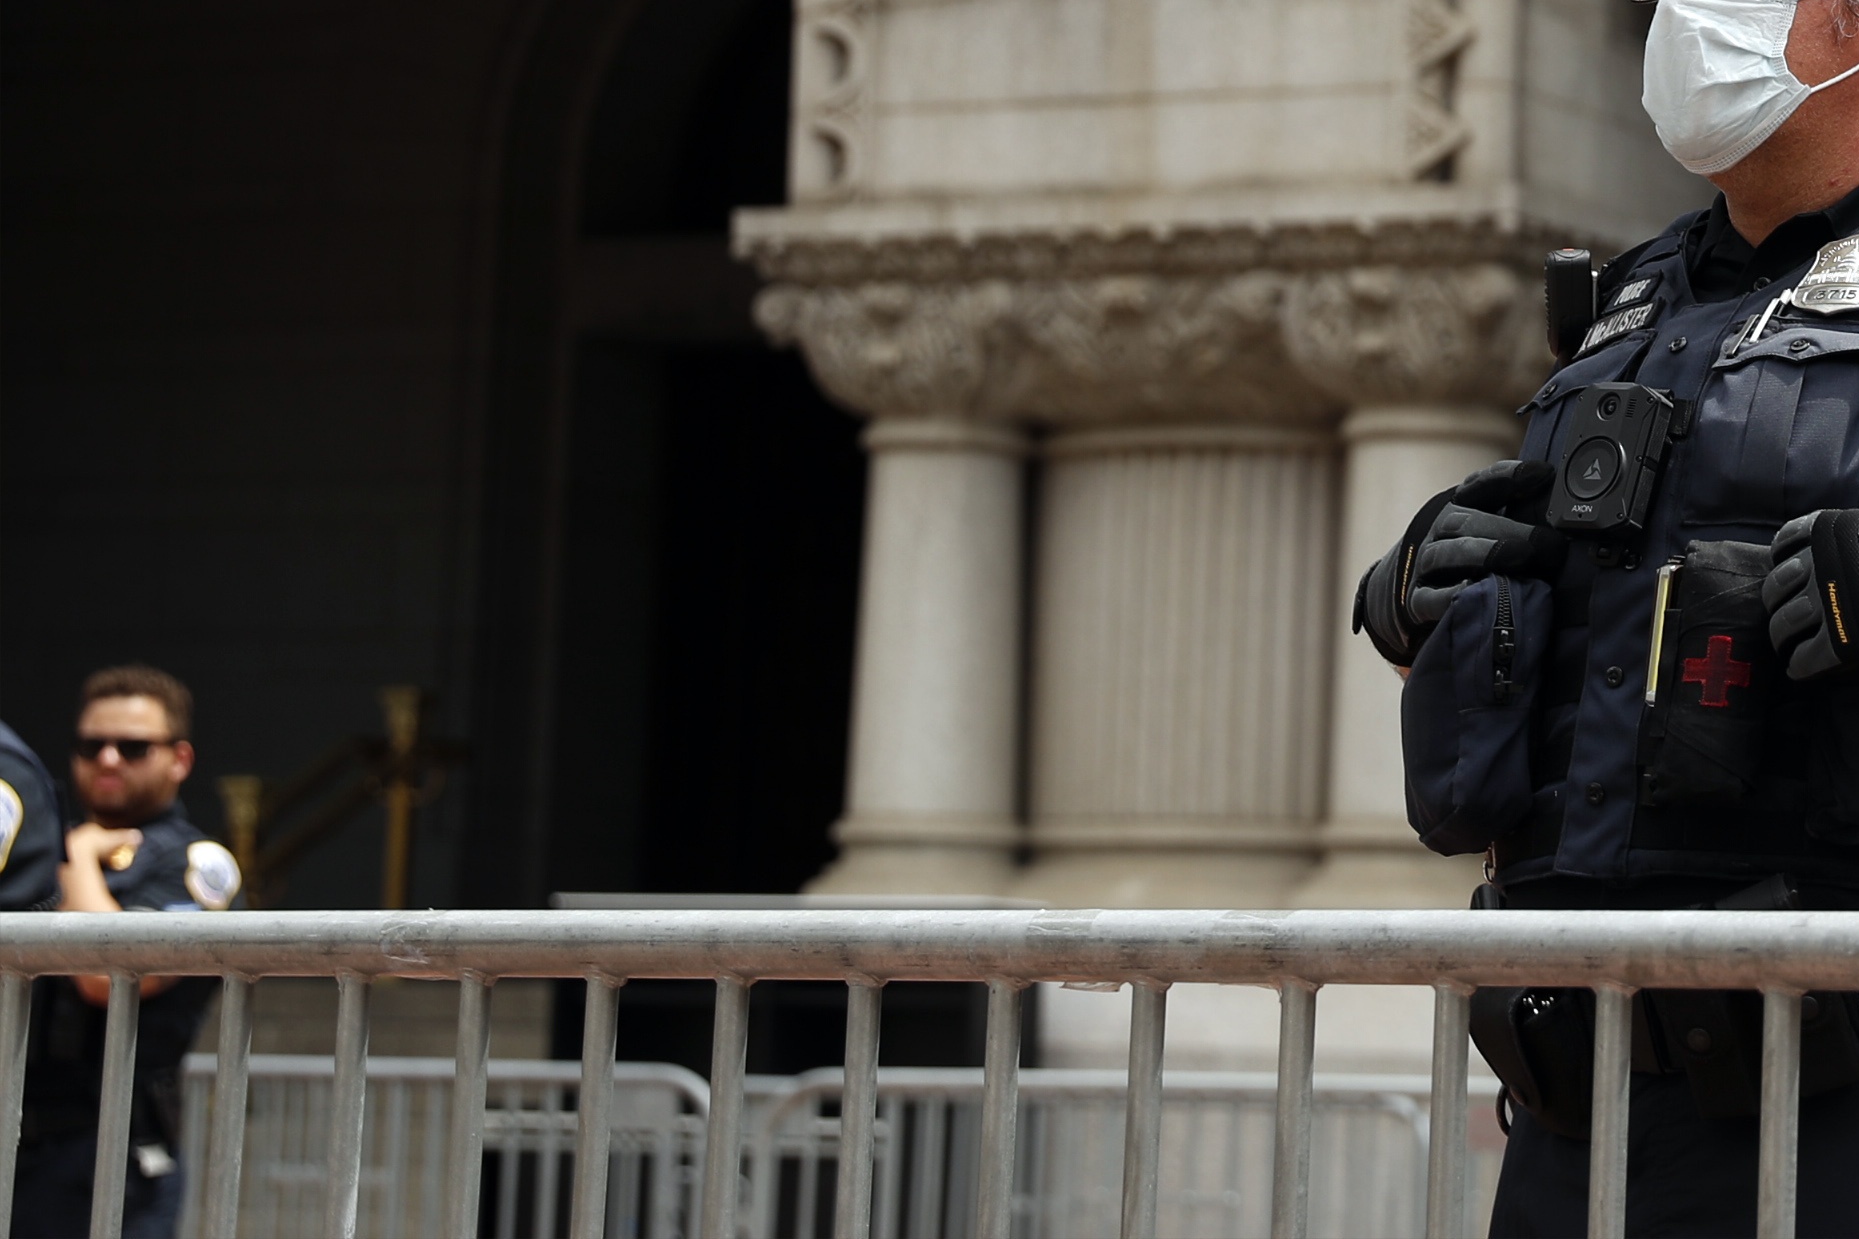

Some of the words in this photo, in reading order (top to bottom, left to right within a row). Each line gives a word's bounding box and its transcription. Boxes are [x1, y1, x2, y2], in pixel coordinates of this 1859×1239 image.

[1814, 289, 1858, 301] 3715
[1571, 504, 1593, 513] AXON
[1827, 582, 1848, 643] Handyman
